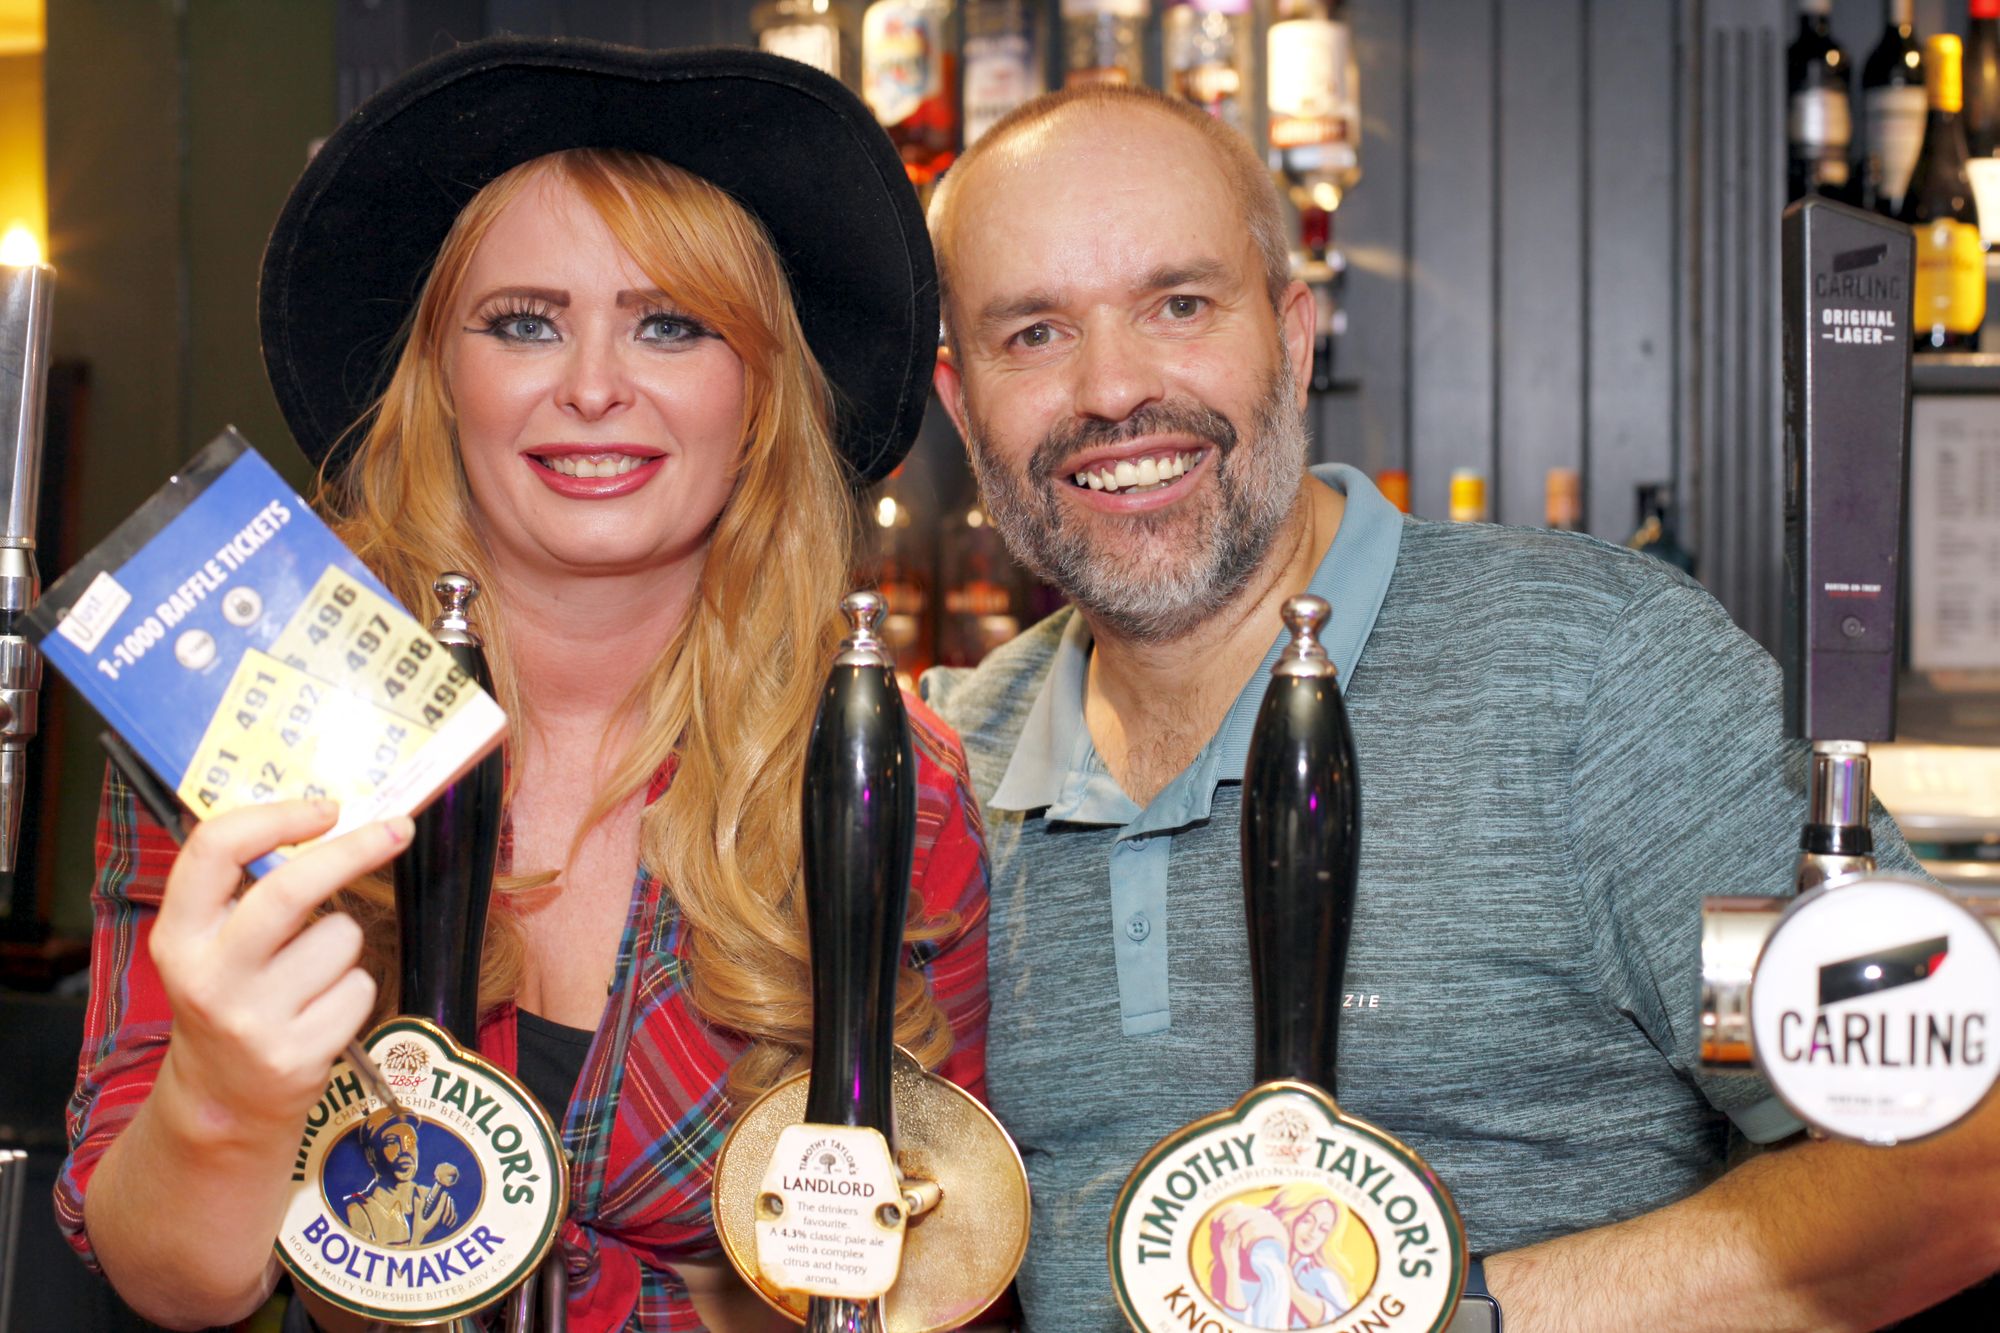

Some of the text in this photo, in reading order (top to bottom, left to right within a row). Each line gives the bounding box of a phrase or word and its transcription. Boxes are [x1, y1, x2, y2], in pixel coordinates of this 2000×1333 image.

[1816, 273, 1900, 299] CARLING
[1822, 309, 1895, 327] ORIGINAL
[97, 616, 164, 680] 1-1000
[156, 560, 228, 628] RAFFLE
[216, 499, 291, 571] TICKETS
[307, 583, 358, 645] 496
[346, 614, 391, 671] 497
[383, 637, 433, 699] 498
[235, 671, 277, 730] 491
[280, 683, 320, 747] 492
[422, 664, 471, 725] 499
[198, 748, 239, 808] 491
[1780, 1011, 1984, 1066] CARLING
[389, 1075, 426, 1087] 1858
[430, 1067, 541, 1205] TAYLOR'S
[440, 1105, 478, 1137] BEERS
[799, 1139, 860, 1176] TIMOTHY TAYLOR'S
[783, 1176, 875, 1197] LANDLORD
[797, 1201, 859, 1216] The drinkers
[1138, 1133, 1439, 1280] TIMOTHY TAYLOR'S
[302, 1214, 506, 1288] BOLTMAKER
[769, 1227, 884, 1248] A 4.3% classic pale ale
[783, 1256, 868, 1276] citrus and hoppy
[787, 1243, 809, 1254] with
[820, 1246, 865, 1261] complex
[289, 1235, 312, 1263] BOLD
[321, 1266, 356, 1291] MALTY
[359, 1285, 422, 1303] YORKSHIRE
[426, 1284, 465, 1300] BITTER
